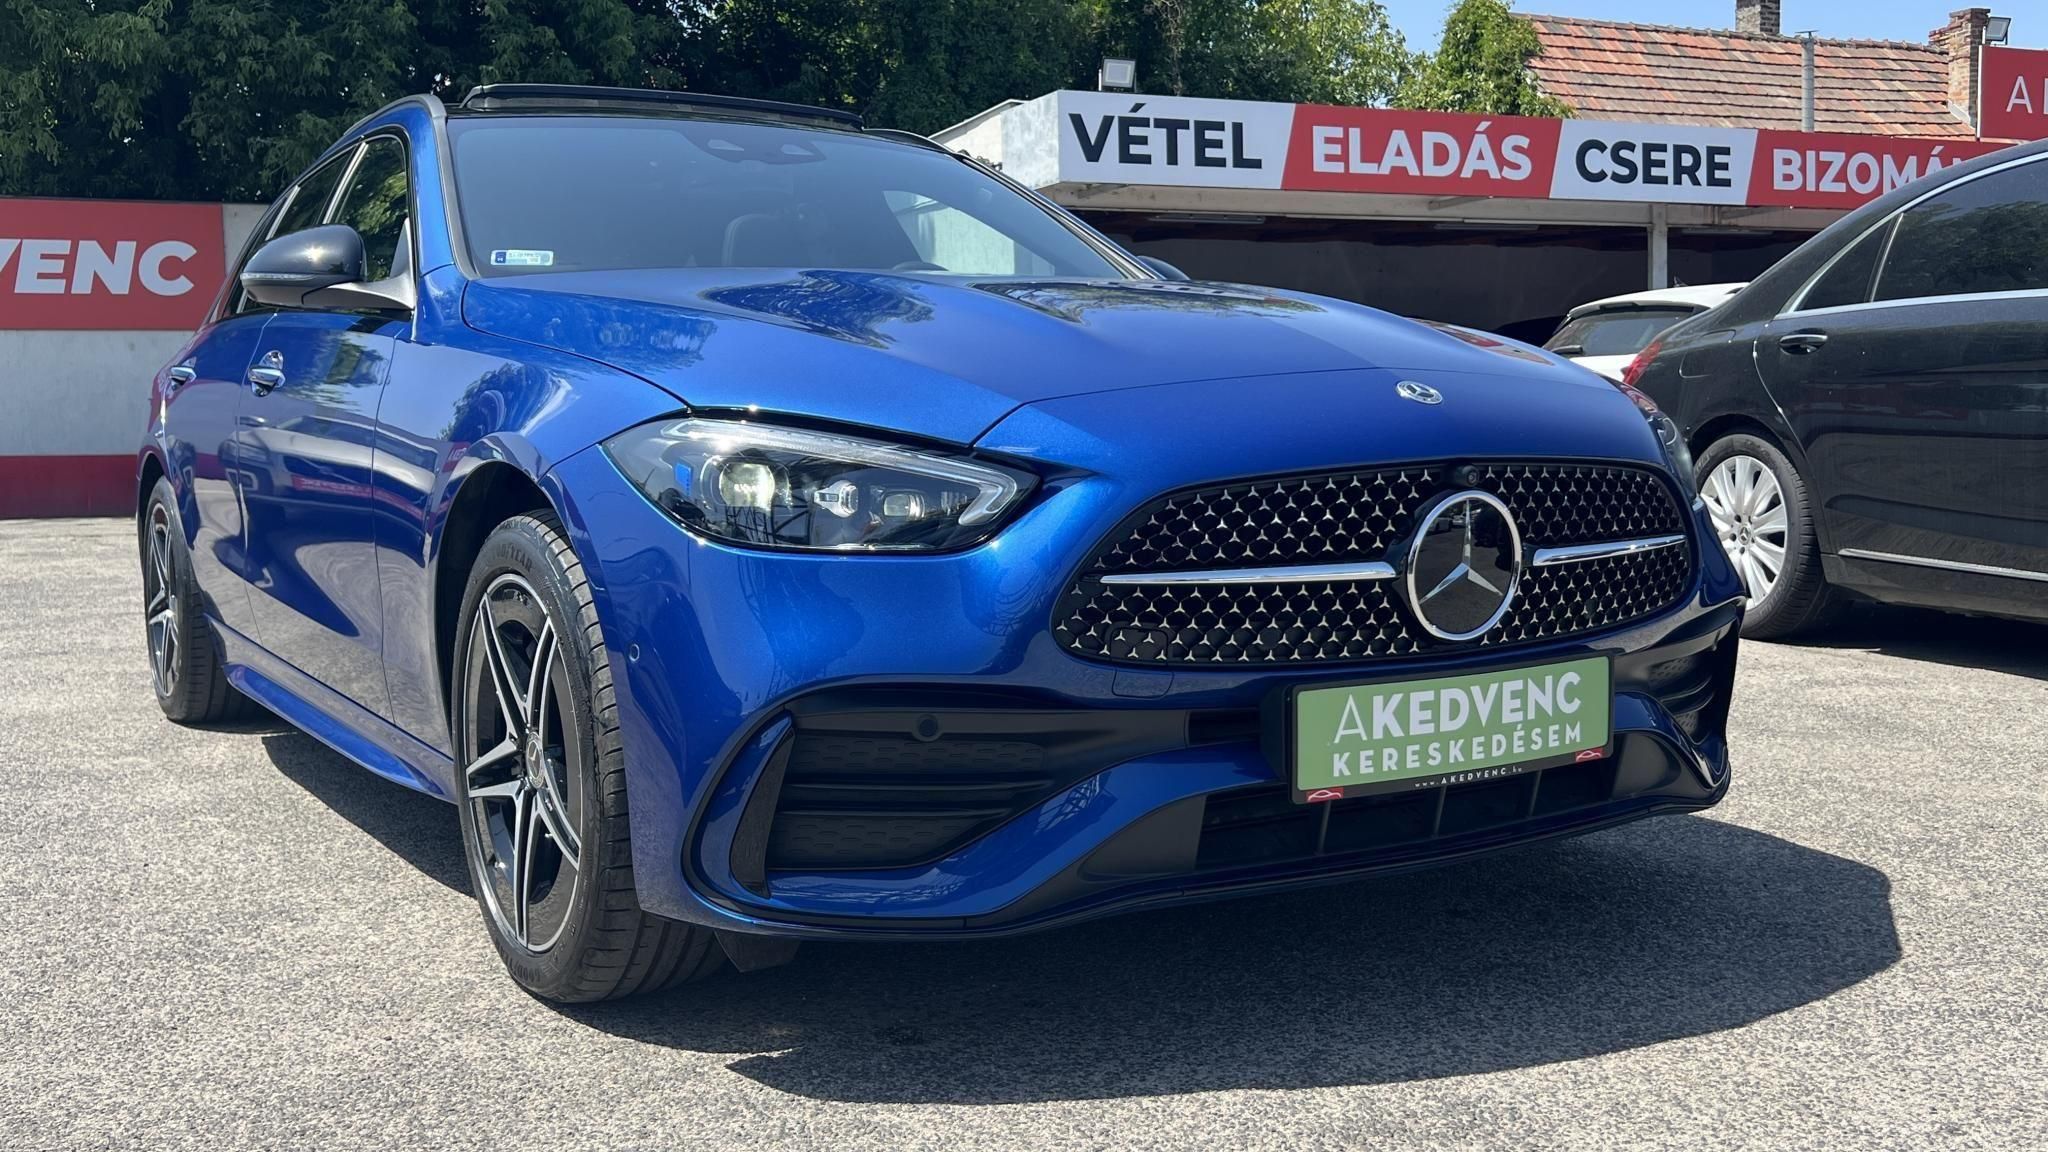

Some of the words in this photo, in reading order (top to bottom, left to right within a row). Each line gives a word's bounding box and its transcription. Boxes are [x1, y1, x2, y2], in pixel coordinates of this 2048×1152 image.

[1068, 103, 1262, 169] VÉTEL
[1312, 121, 1532, 181] ELADÁS
[1575, 139, 1732, 188] CSERE
[1773, 146, 1963, 195] BIZOMÁ
[1333, 671, 1582, 744] AKEDVENC
[1332, 721, 1581, 777] KERESKEDÉSEM
